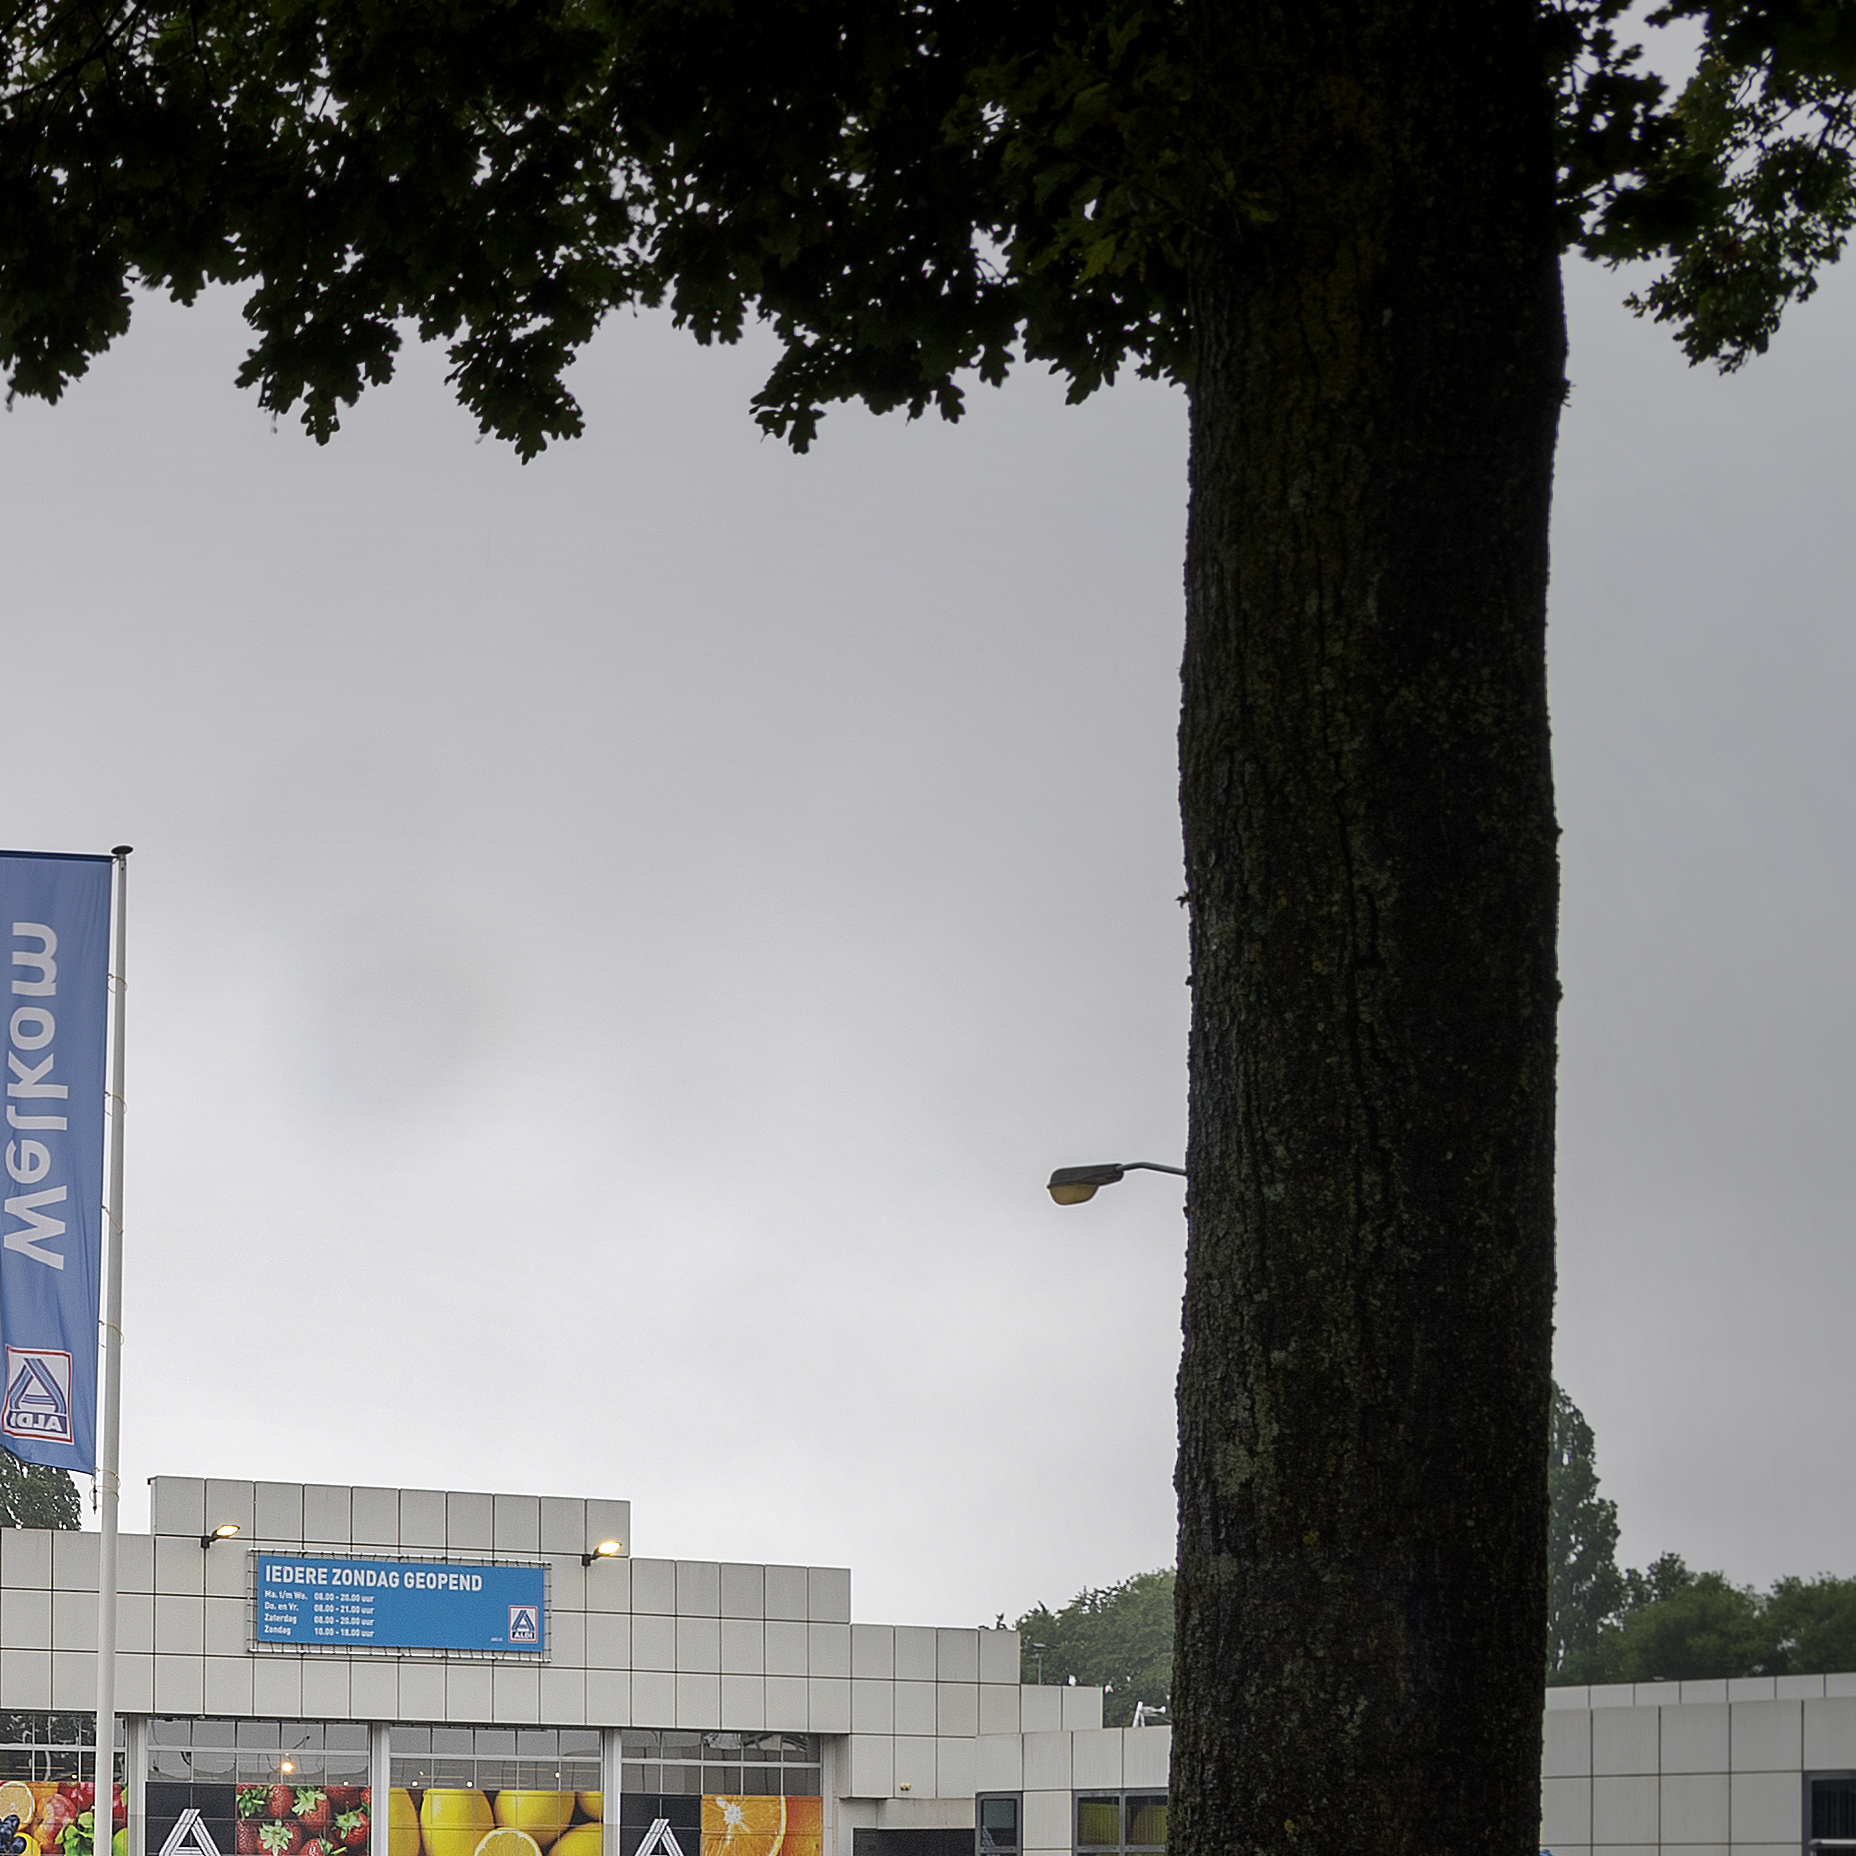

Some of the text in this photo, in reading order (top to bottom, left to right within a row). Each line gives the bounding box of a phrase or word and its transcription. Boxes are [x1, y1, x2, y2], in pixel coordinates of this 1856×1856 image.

[265, 1565, 483, 1592] IEDERE ZONDAG GEOPEND
[264, 1613, 297, 1625] Zaterdag
[264, 1624, 291, 1636] Zondag
[514, 1631, 533, 1639] ALDI
